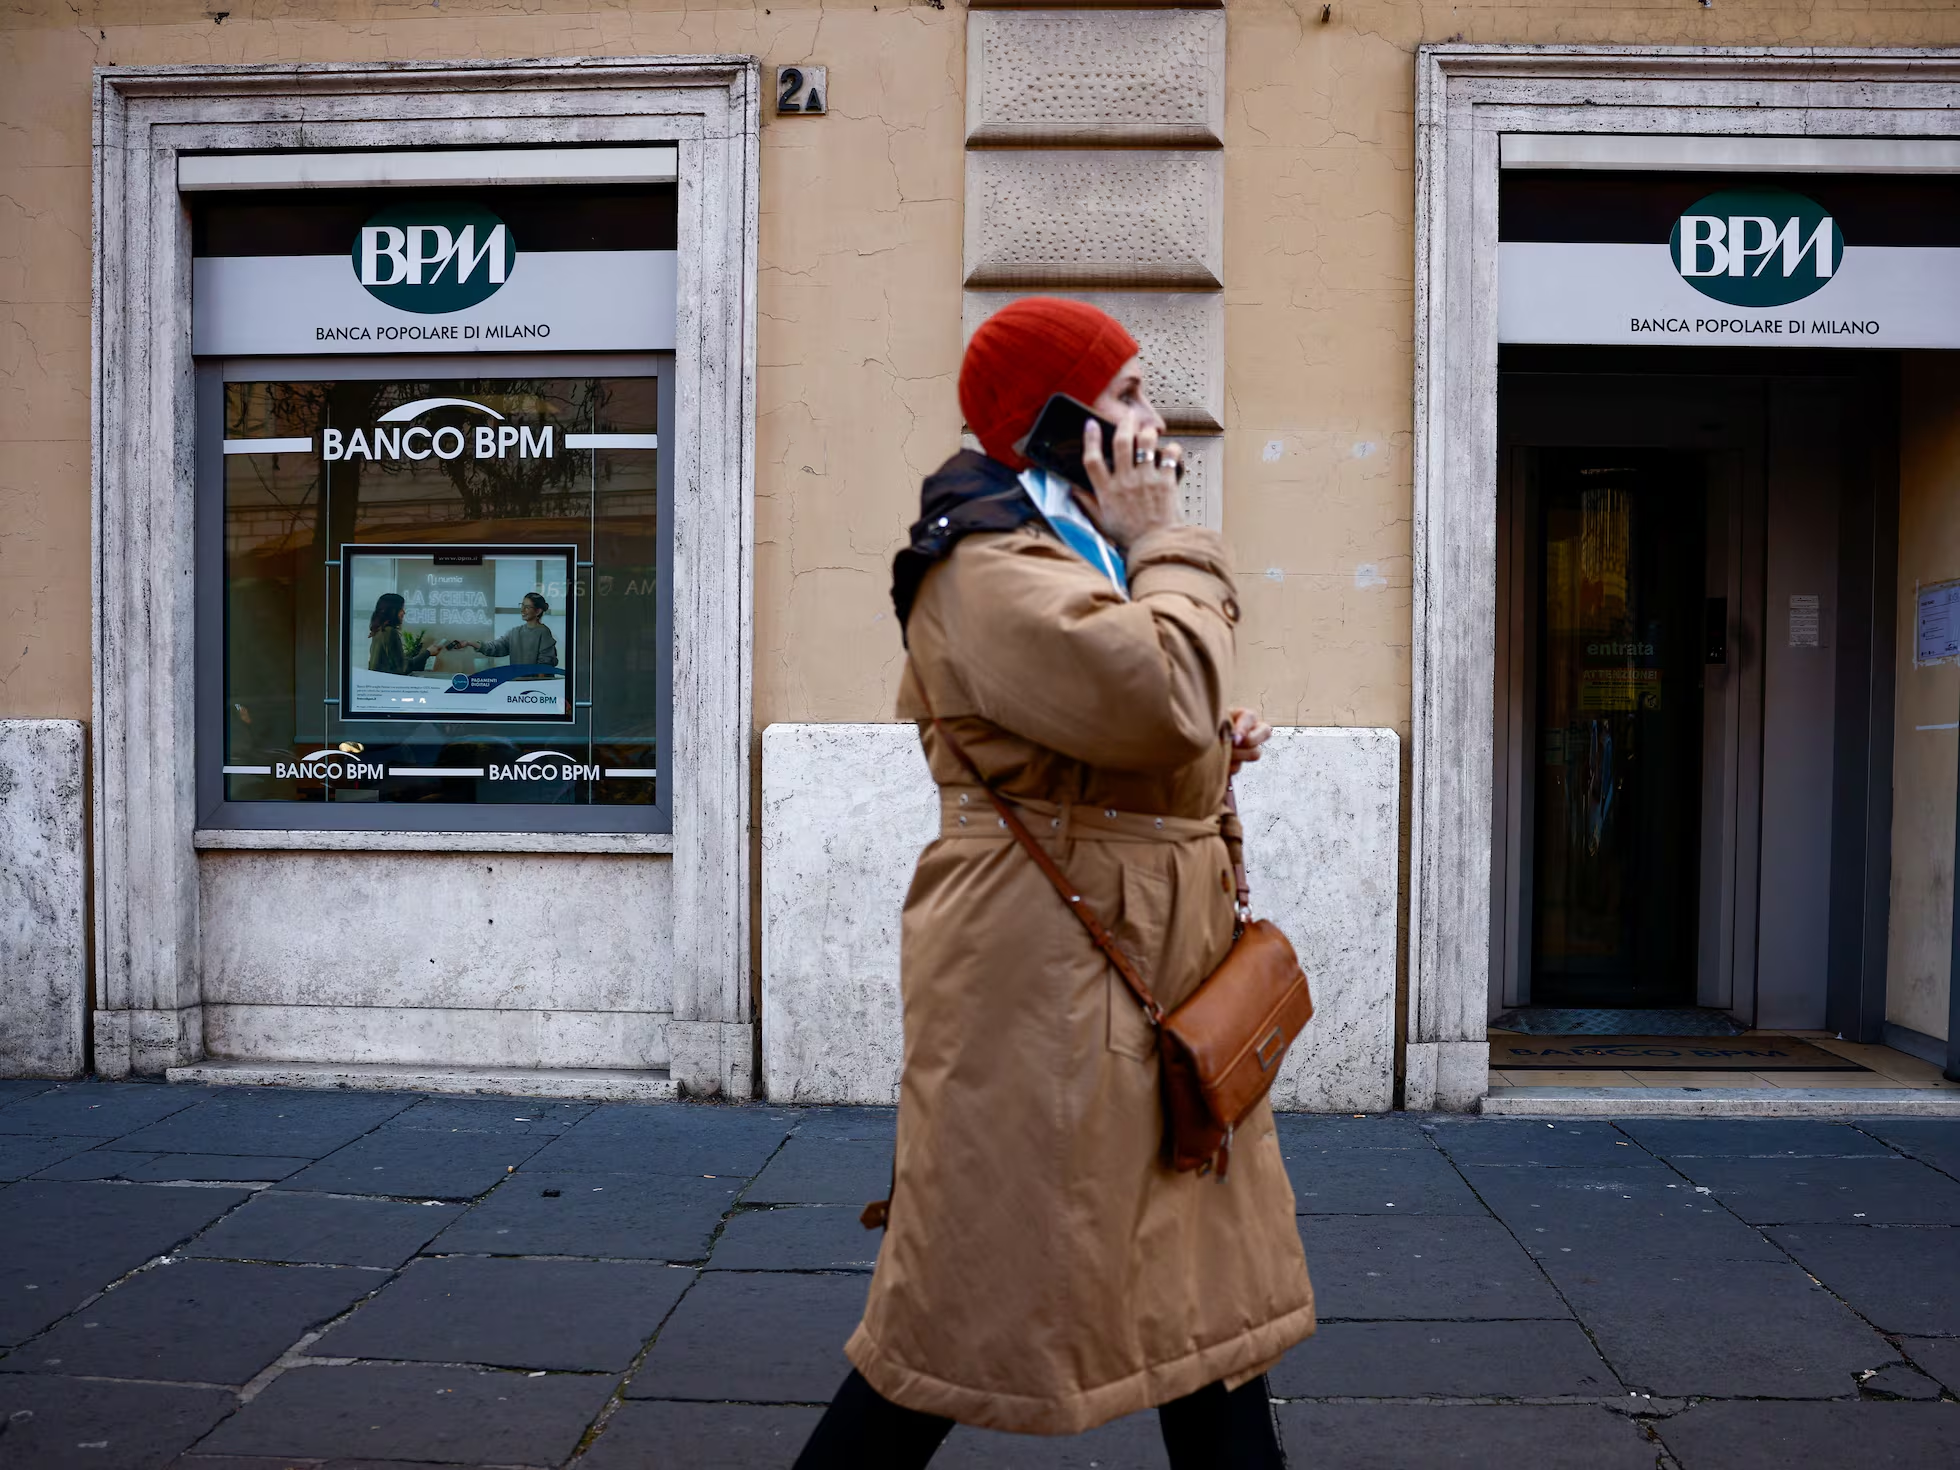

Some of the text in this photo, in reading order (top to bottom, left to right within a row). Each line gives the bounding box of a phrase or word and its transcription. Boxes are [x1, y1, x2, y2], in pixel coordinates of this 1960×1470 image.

[361, 224, 506, 286] BPM
[1680, 215, 1833, 278] BPM
[316, 324, 551, 340] BANCA POPOLARE DI MILANO
[1631, 318, 1880, 335] BANCA POPOLARE DI MILANO
[323, 425, 553, 461] BANCO BPM
[404, 590, 488, 607] LA SCELTA
[404, 608, 492, 625] CHE PAGA.
[1586, 641, 1654, 656] entrata
[507, 695, 557, 704] BANCO BPM
[275, 762, 384, 780] BANCO BPM
[489, 763, 600, 781] BANCO BPM
[1508, 1046, 1789, 1058] BANCO BPM
